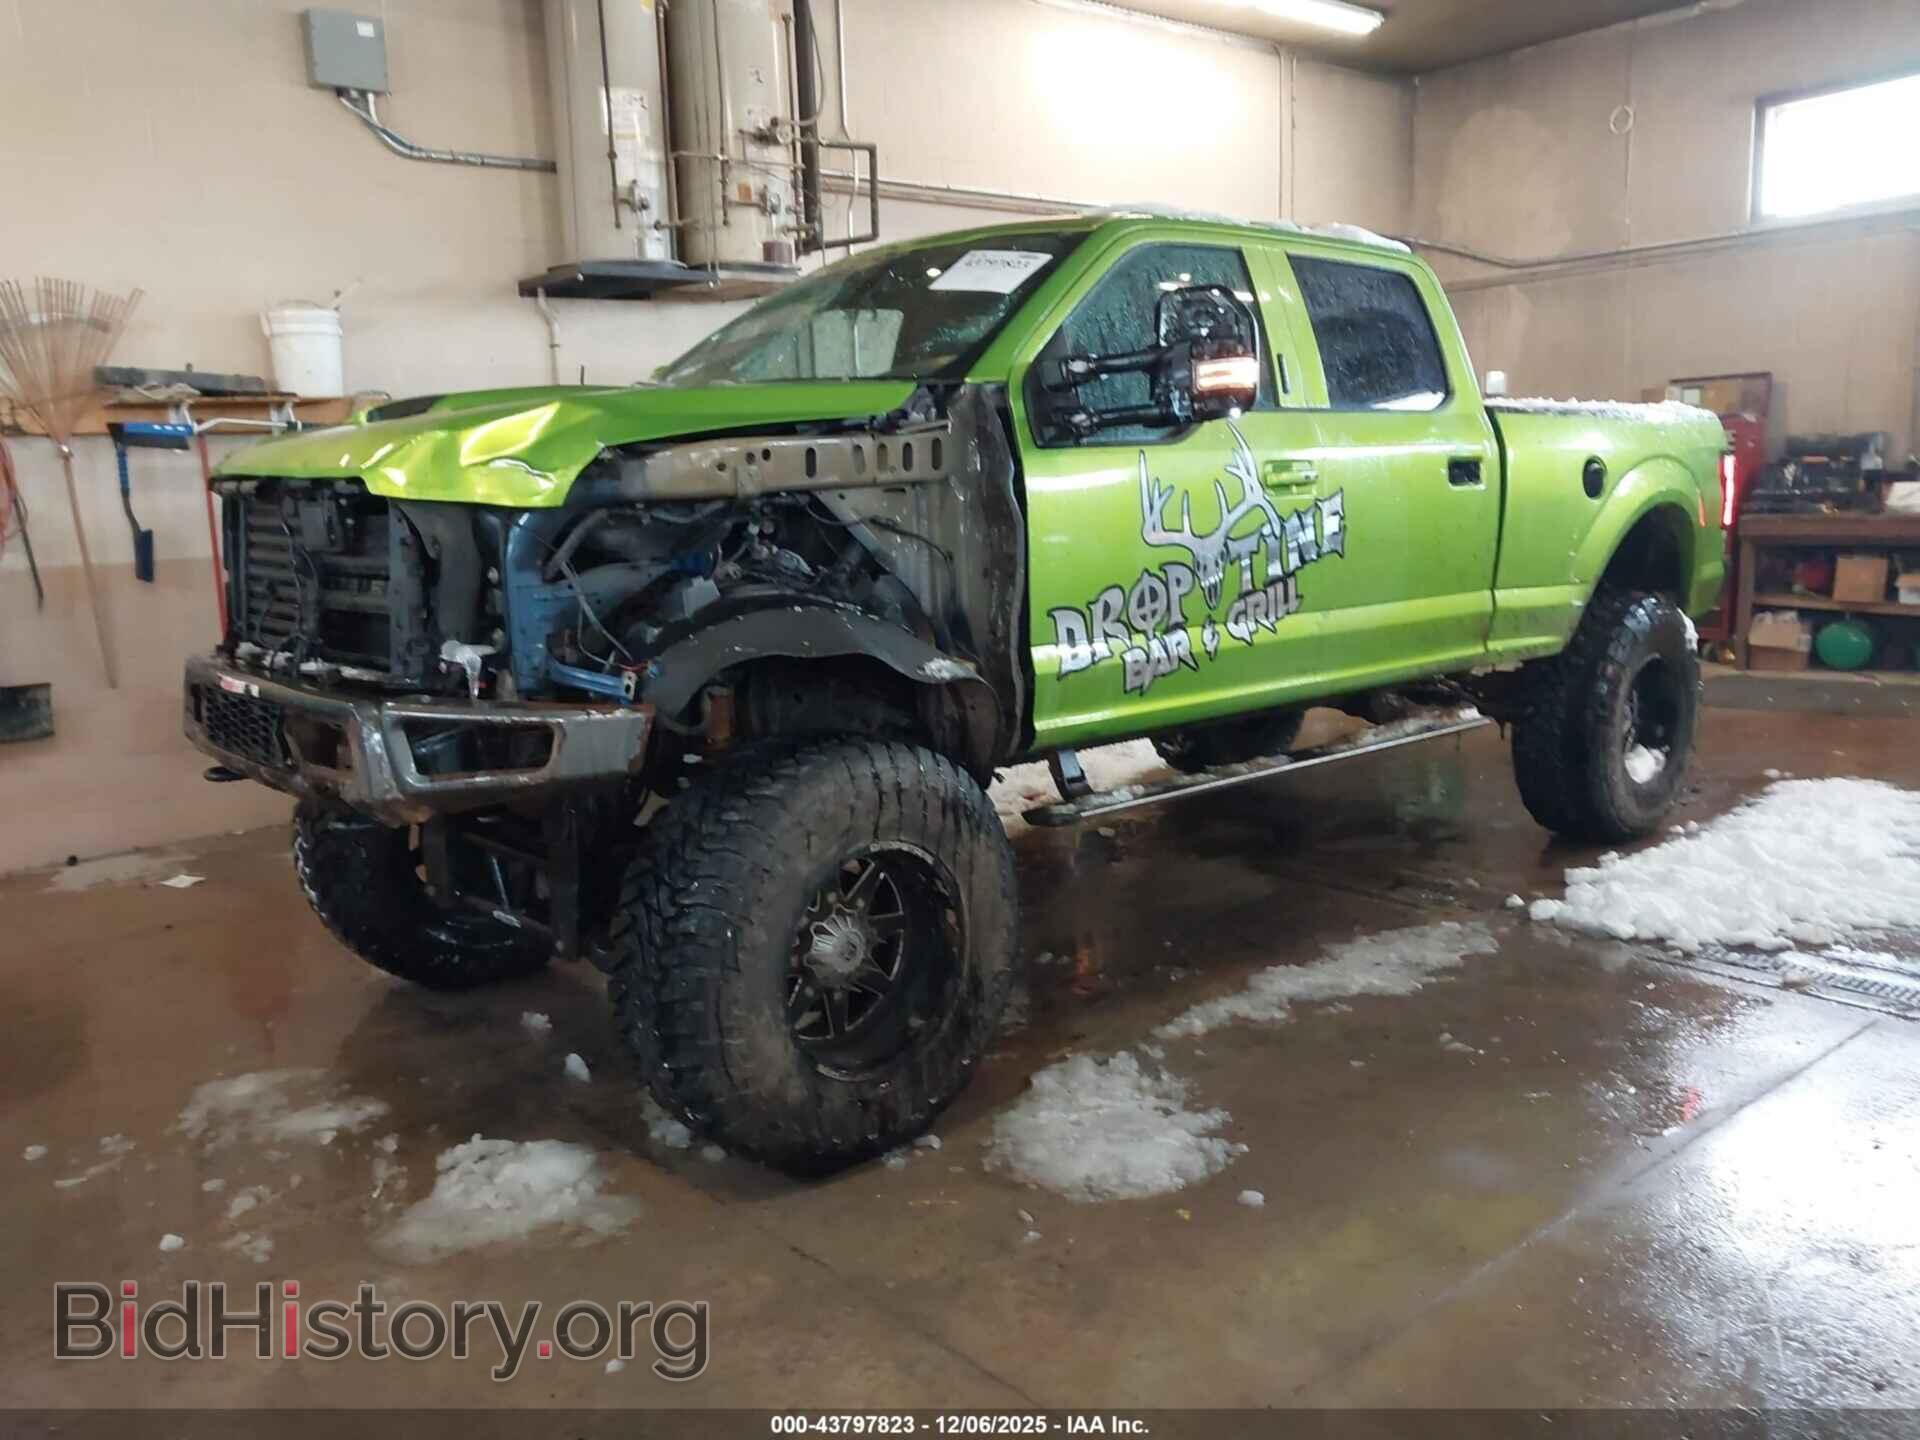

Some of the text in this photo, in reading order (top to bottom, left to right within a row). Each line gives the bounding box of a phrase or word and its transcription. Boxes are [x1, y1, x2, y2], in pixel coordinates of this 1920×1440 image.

[1048, 487, 1346, 681] DROP TINE
[1120, 628, 1199, 696] BAR
[1225, 575, 1303, 646] GRILL
